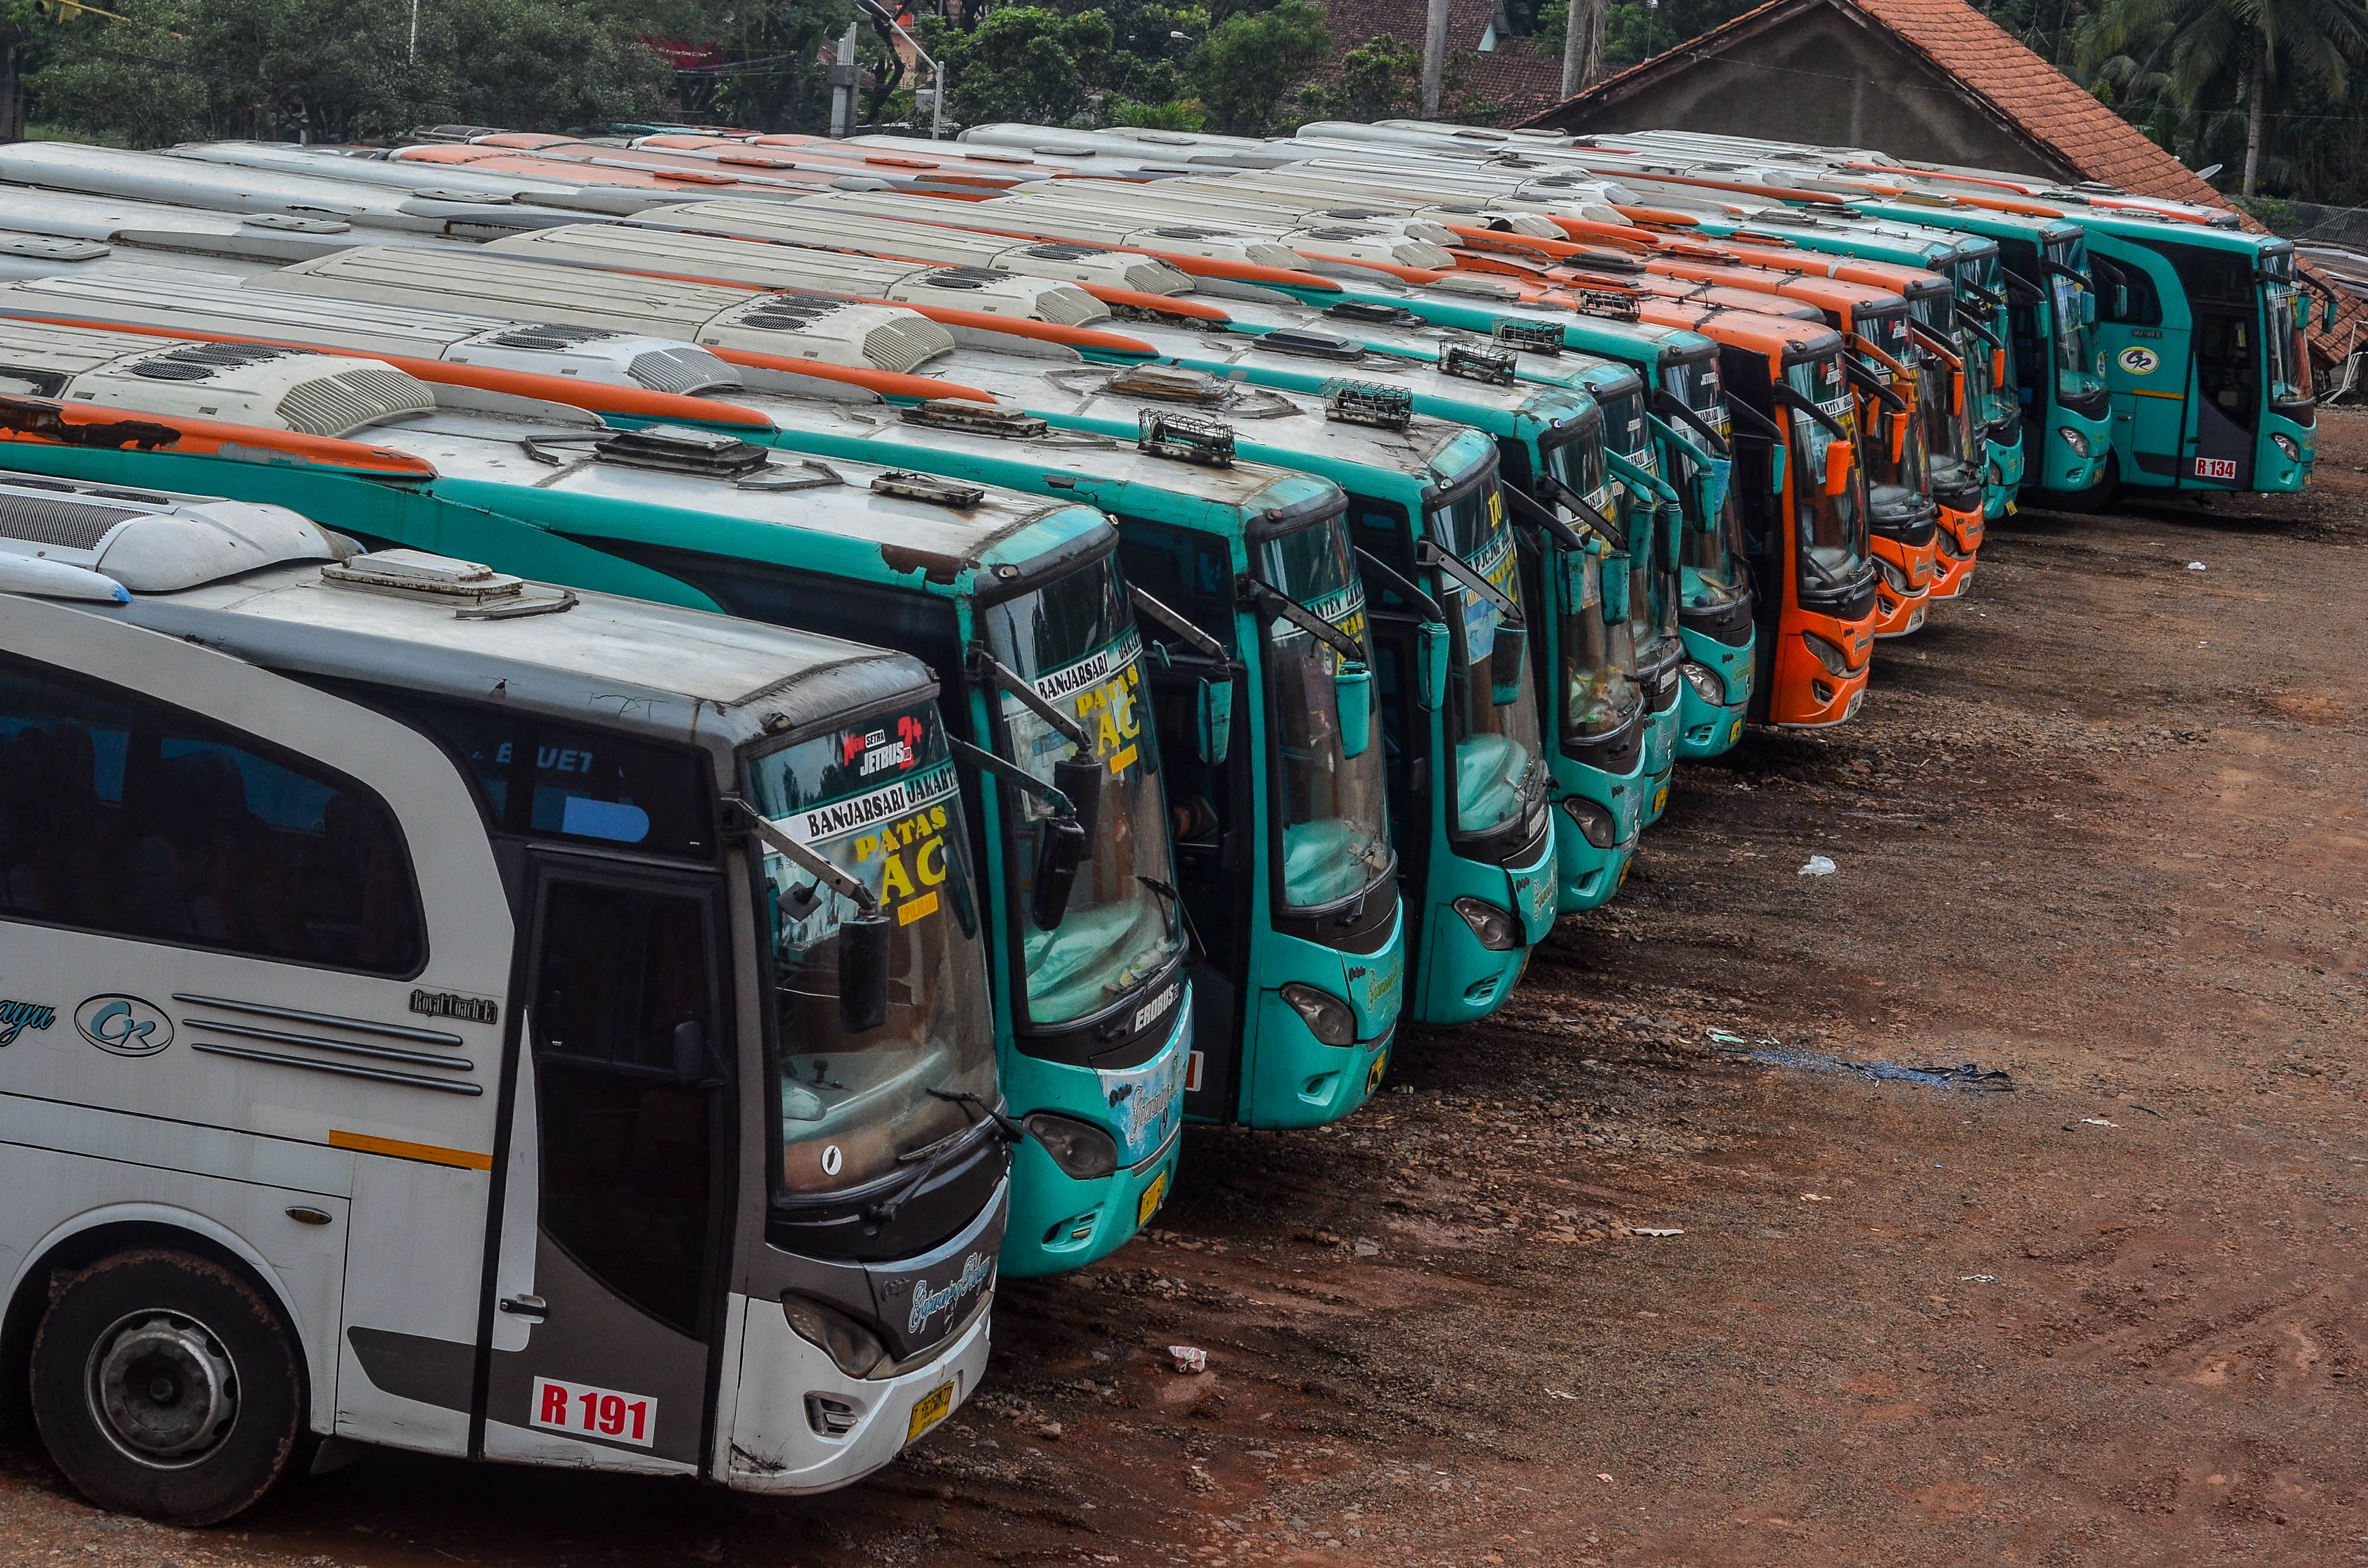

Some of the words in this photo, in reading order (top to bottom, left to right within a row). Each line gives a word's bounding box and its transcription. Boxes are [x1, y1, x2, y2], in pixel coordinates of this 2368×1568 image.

[2198, 459, 2206, 474] R
[2210, 461, 2234, 477] 134
[1038, 653, 1109, 700] BANJARSARI
[1076, 664, 1138, 718] PATAS
[866, 730, 885, 747] SETRA
[1098, 693, 1140, 756] AC
[860, 741, 904, 776] JETBUS
[807, 786, 906, 838] BANJARSARI
[855, 806, 947, 862] PATAS
[880, 835, 947, 906] AC
[414, 990, 444, 1016] Royal
[449, 996, 479, 1019] Coach
[540, 1383, 568, 1425] R
[579, 1392, 646, 1440] 191
